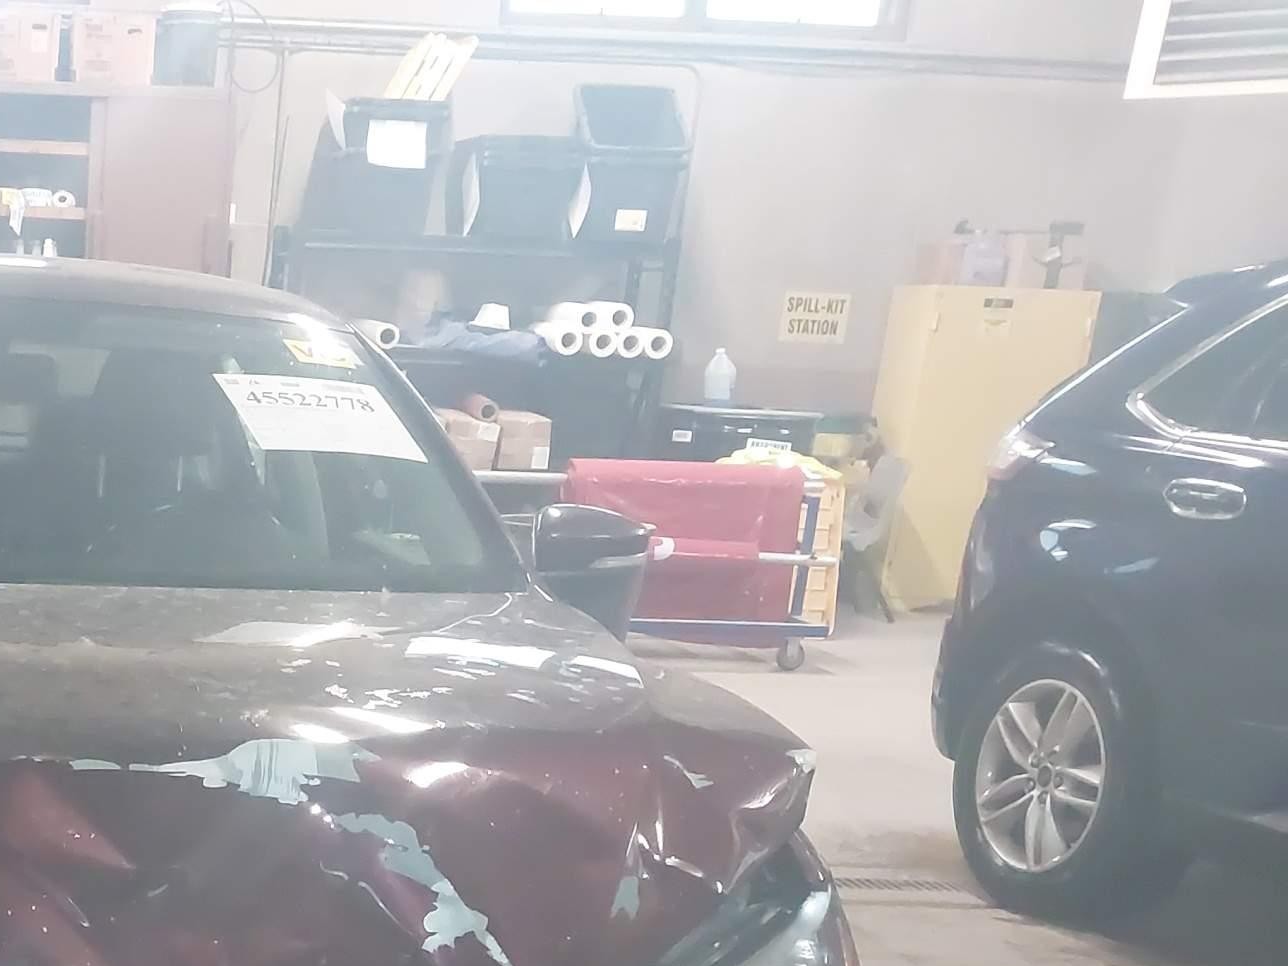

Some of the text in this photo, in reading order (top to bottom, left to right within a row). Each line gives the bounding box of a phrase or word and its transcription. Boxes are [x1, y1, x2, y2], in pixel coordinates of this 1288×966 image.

[787, 296, 847, 314] SPILL-KIT
[787, 318, 839, 336] STATION
[246, 391, 375, 413] 45522778
